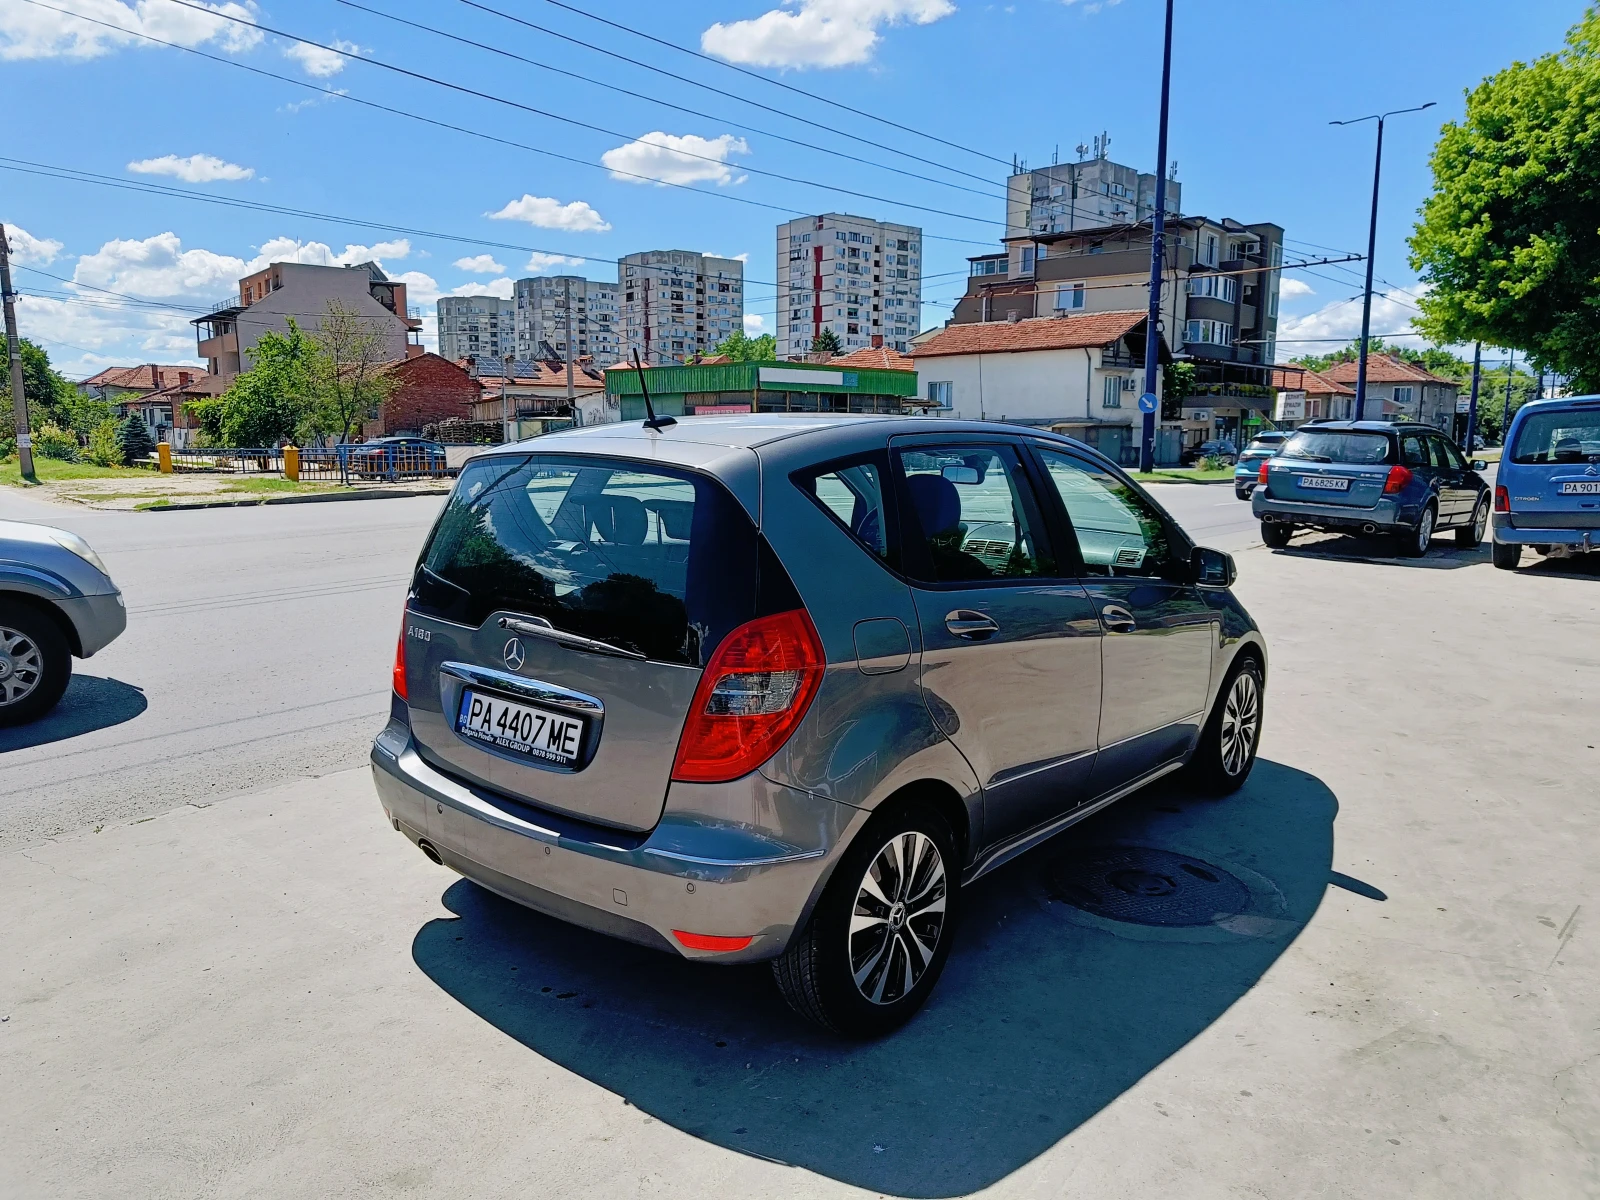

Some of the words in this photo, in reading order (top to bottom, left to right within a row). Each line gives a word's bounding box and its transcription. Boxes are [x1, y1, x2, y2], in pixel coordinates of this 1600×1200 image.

[1302, 477, 1314, 486] PA
[1314, 478, 1334, 488] 6825
[1334, 479, 1346, 489] KK
[1564, 483, 1578, 492] PA
[1580, 483, 1600, 492] 901
[468, 698, 493, 732] PA
[496, 706, 547, 745] 4407
[547, 718, 579, 756] ME
[495, 736, 509, 747] ALEX
[509, 739, 531, 753] GROUP
[545, 752, 556, 761] 999
